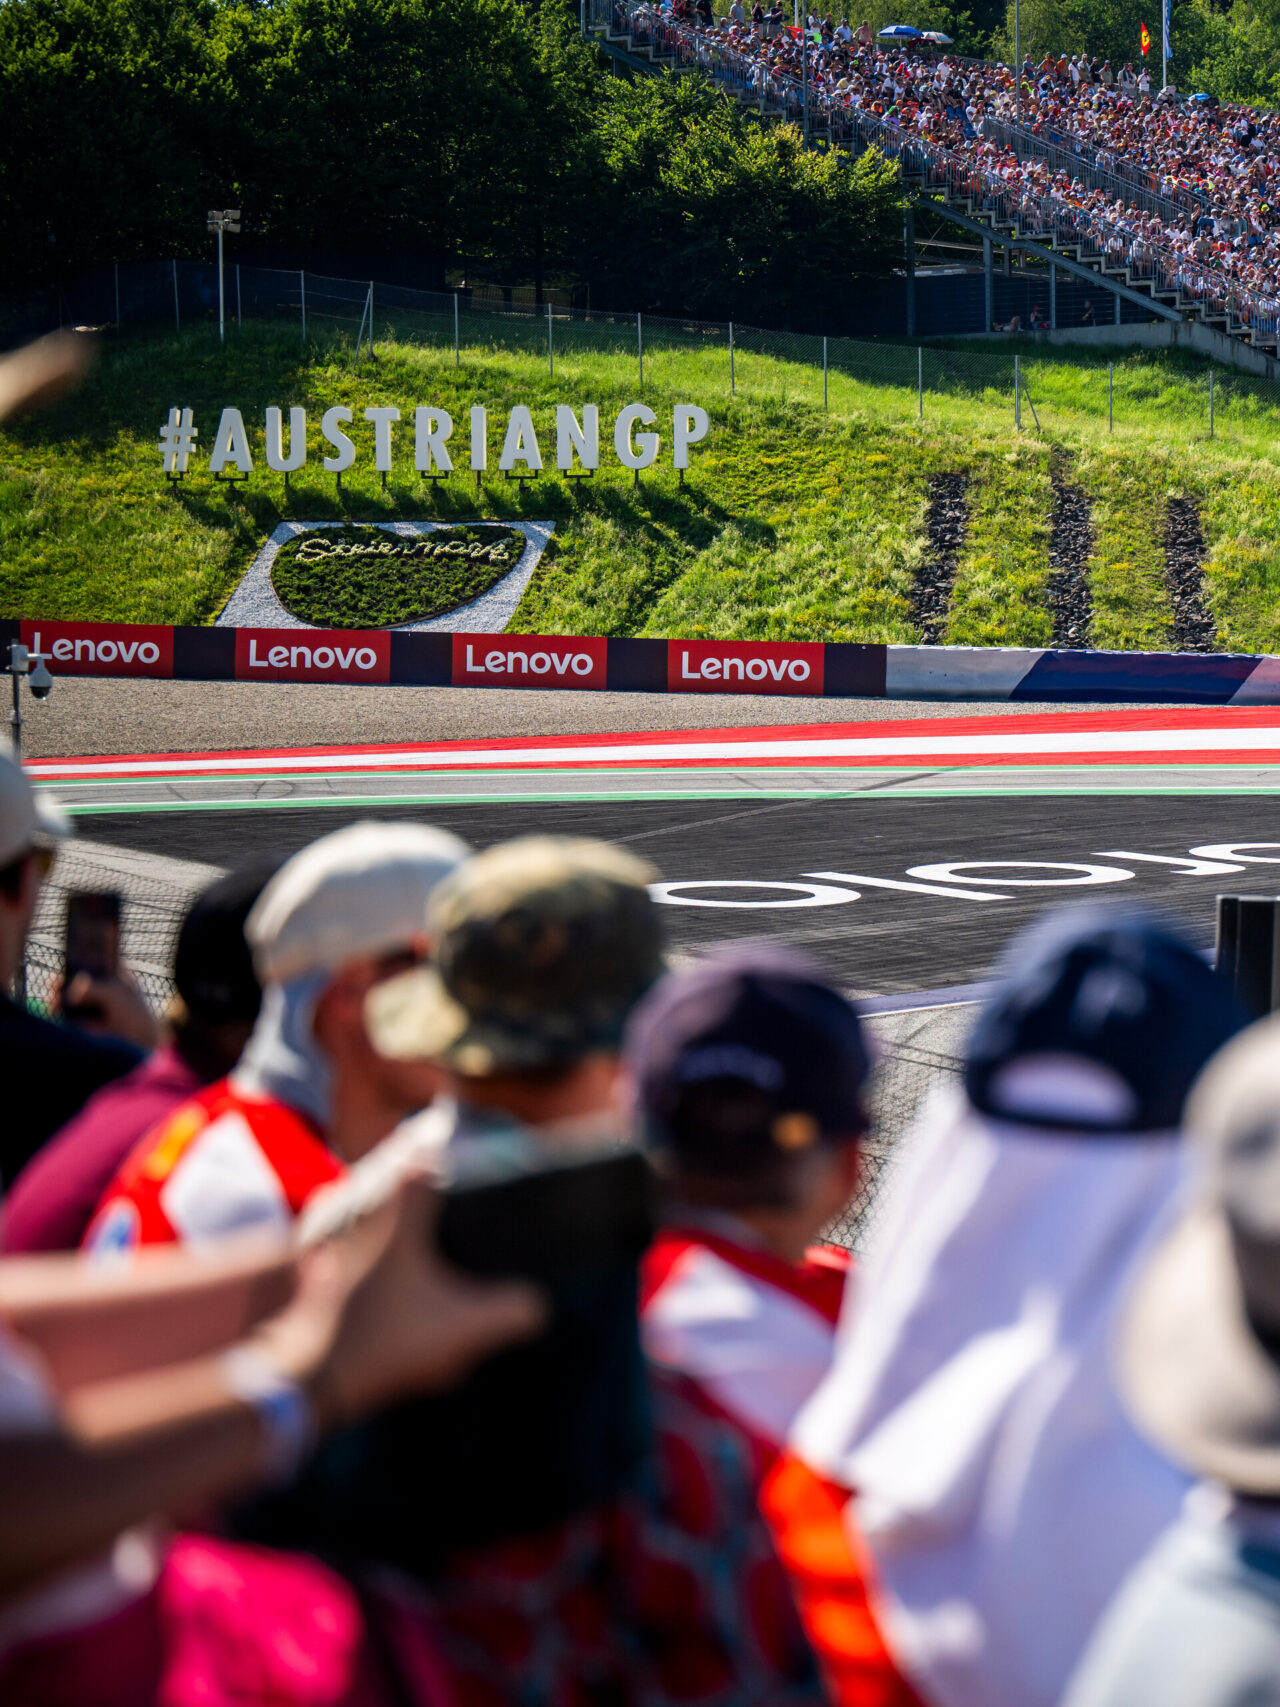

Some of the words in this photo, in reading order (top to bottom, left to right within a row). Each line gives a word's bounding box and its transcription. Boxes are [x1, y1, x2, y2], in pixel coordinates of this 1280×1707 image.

[158, 403, 710, 473] #AUSTRIANGP
[33, 632, 160, 664] Lenovo
[249, 639, 377, 670] Lenovo
[466, 645, 593, 675] Lenovo
[682, 651, 811, 681] Lenovo
